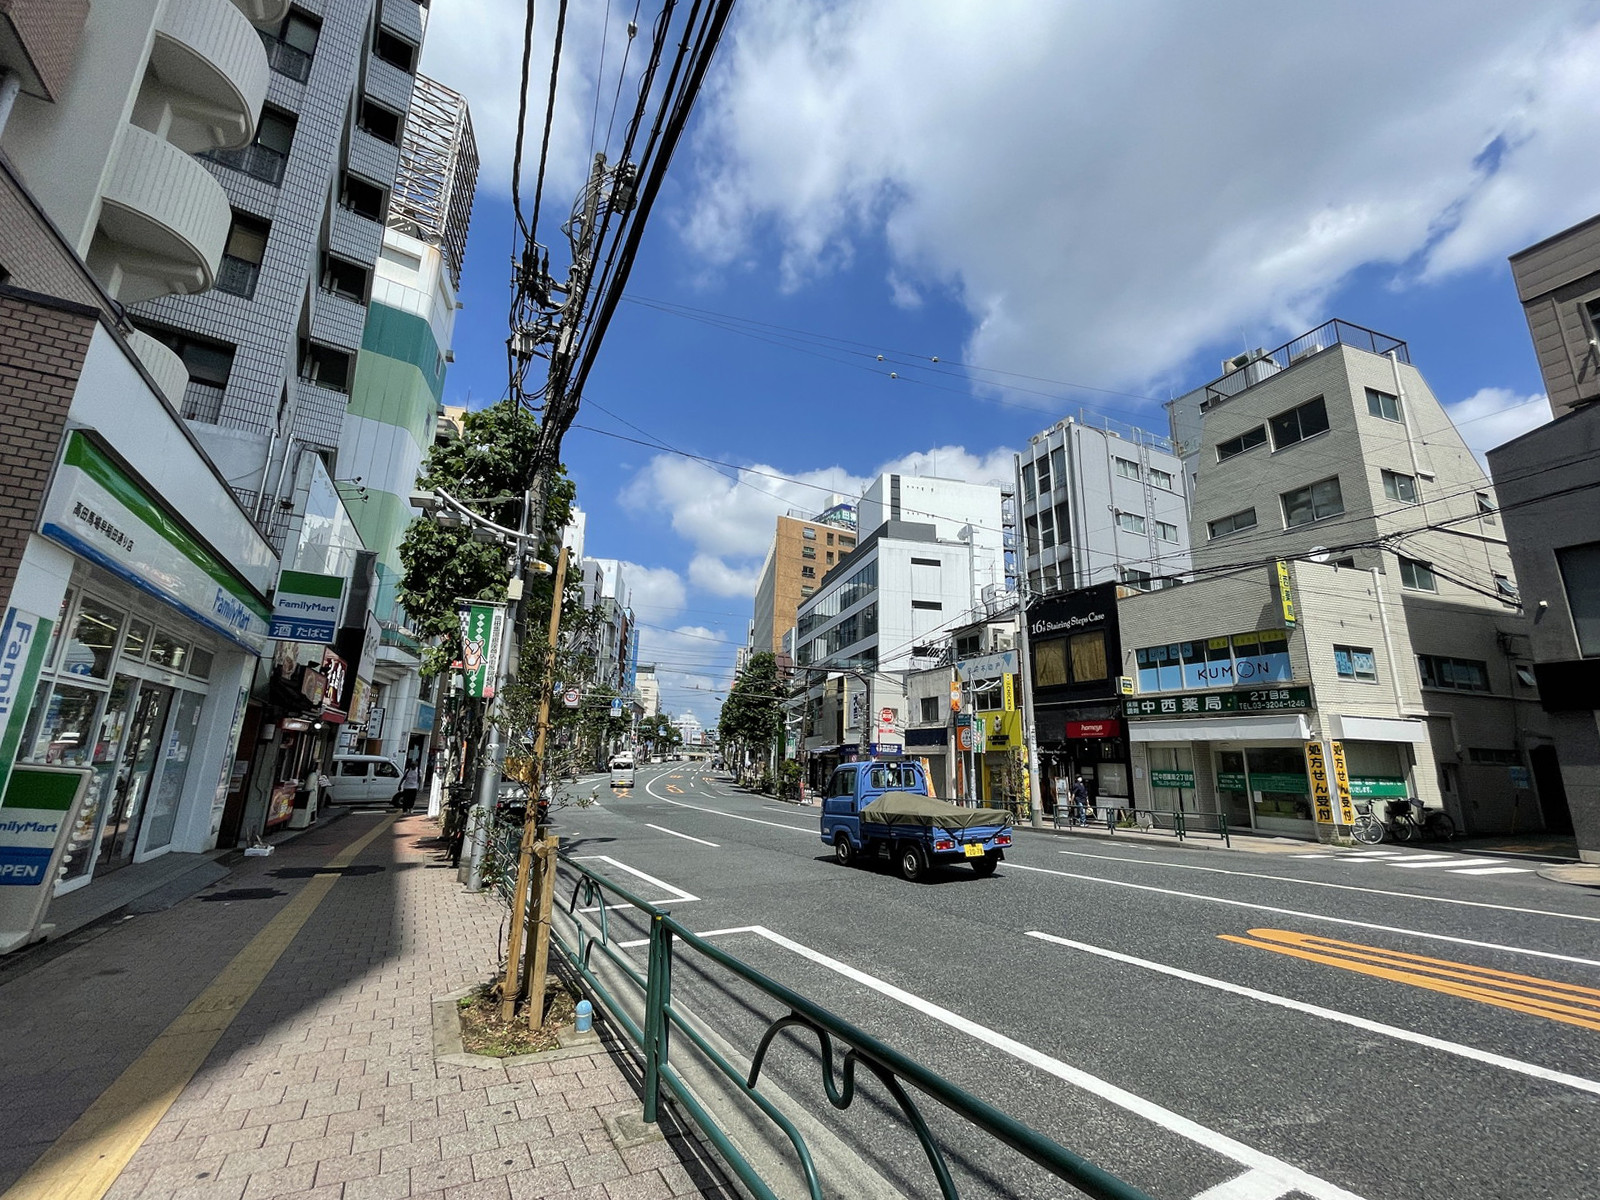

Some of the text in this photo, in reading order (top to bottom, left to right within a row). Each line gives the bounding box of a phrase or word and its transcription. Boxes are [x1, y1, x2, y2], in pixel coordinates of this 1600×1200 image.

[212, 587, 250, 631] FamilyMart
[279, 599, 335, 612] FamilyMart
[1070, 616, 1088, 626] Steps
[1088, 612, 1105, 622] Case
[273, 623, 330, 639] 酒 たばこ
[1197, 661, 1269, 681] KUMON
[1250, 690, 1290, 701] 2丁目店
[1142, 696, 1222, 713] 中西薬局
[1308, 744, 1330, 820] 処方せん受付
[1333, 744, 1352, 821] 処方せん受付
[0, 864, 39, 877] PEN
